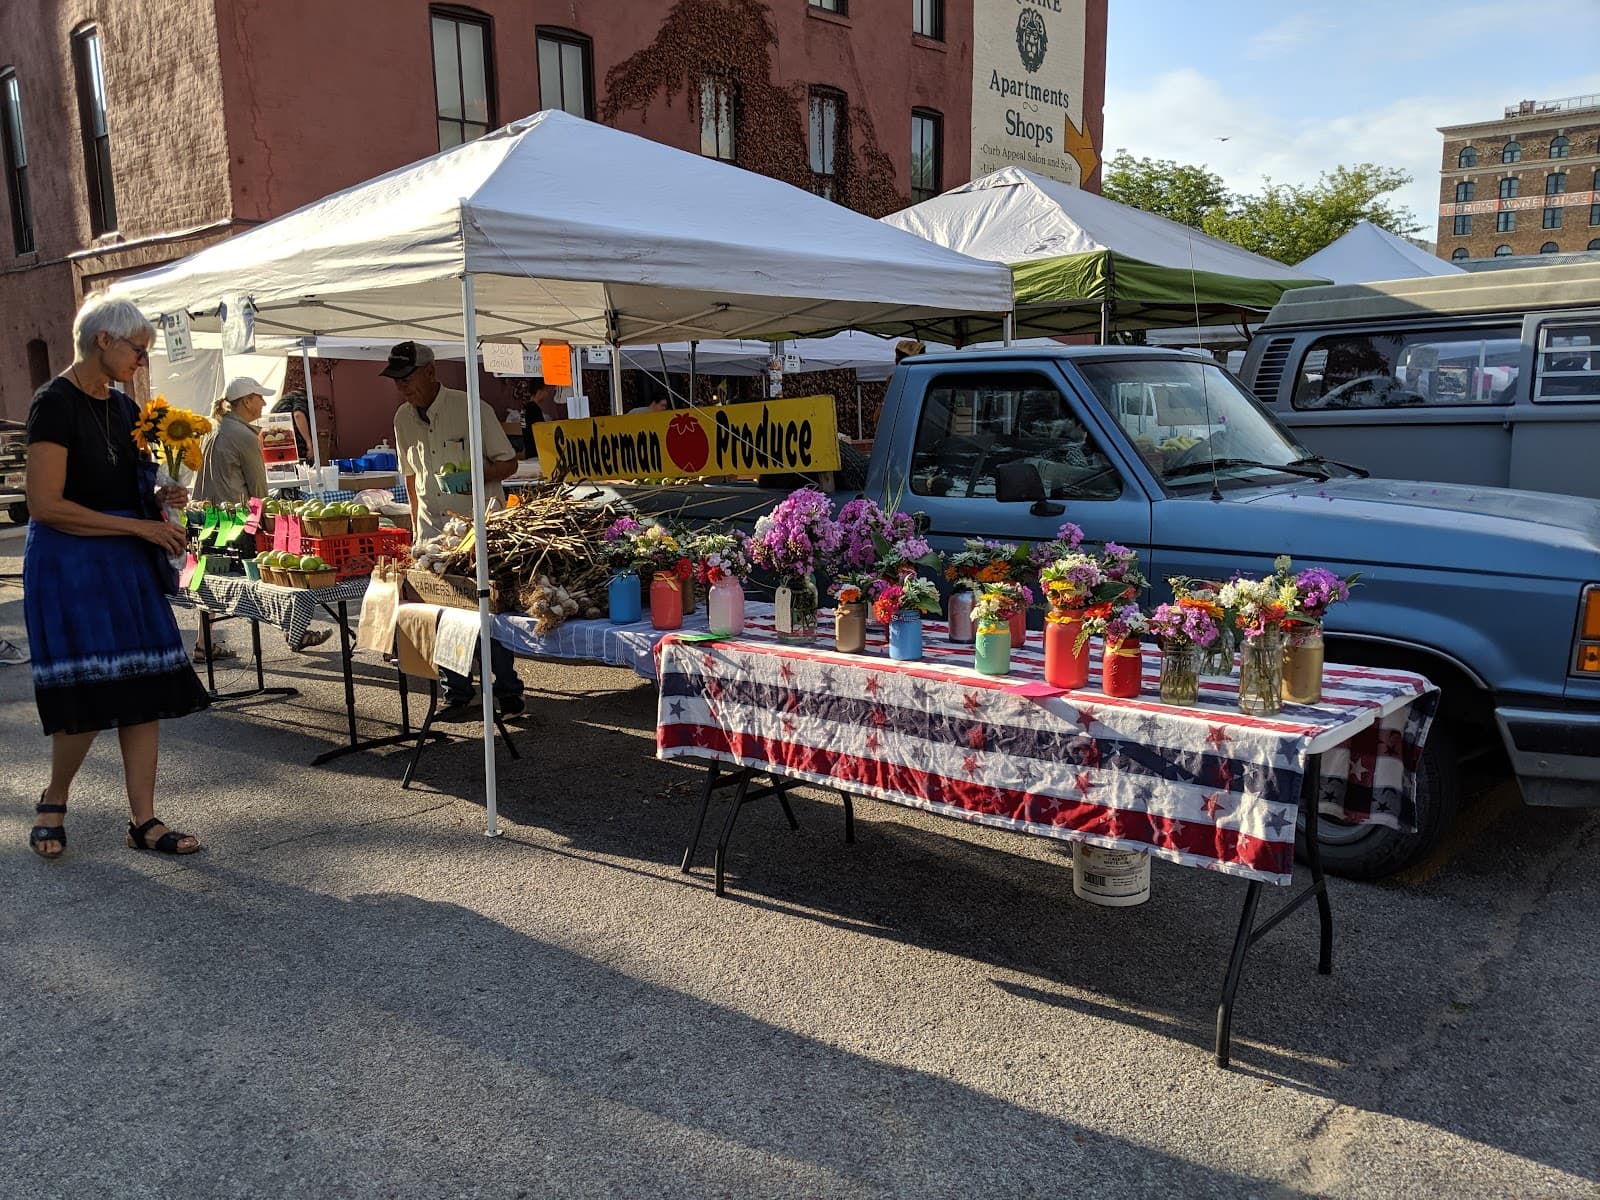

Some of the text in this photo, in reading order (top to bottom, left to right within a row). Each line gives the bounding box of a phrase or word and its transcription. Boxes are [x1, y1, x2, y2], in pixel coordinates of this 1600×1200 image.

[989, 69, 1070, 109] Apartments
[1005, 109, 1053, 148] Shops
[982, 144, 1000, 156] Curb
[1002, 147, 1026, 162] Appeal
[1027, 152, 1046, 165] Salon
[1047, 157, 1060, 168] and
[553, 404, 812, 477] Sunderman Produce
